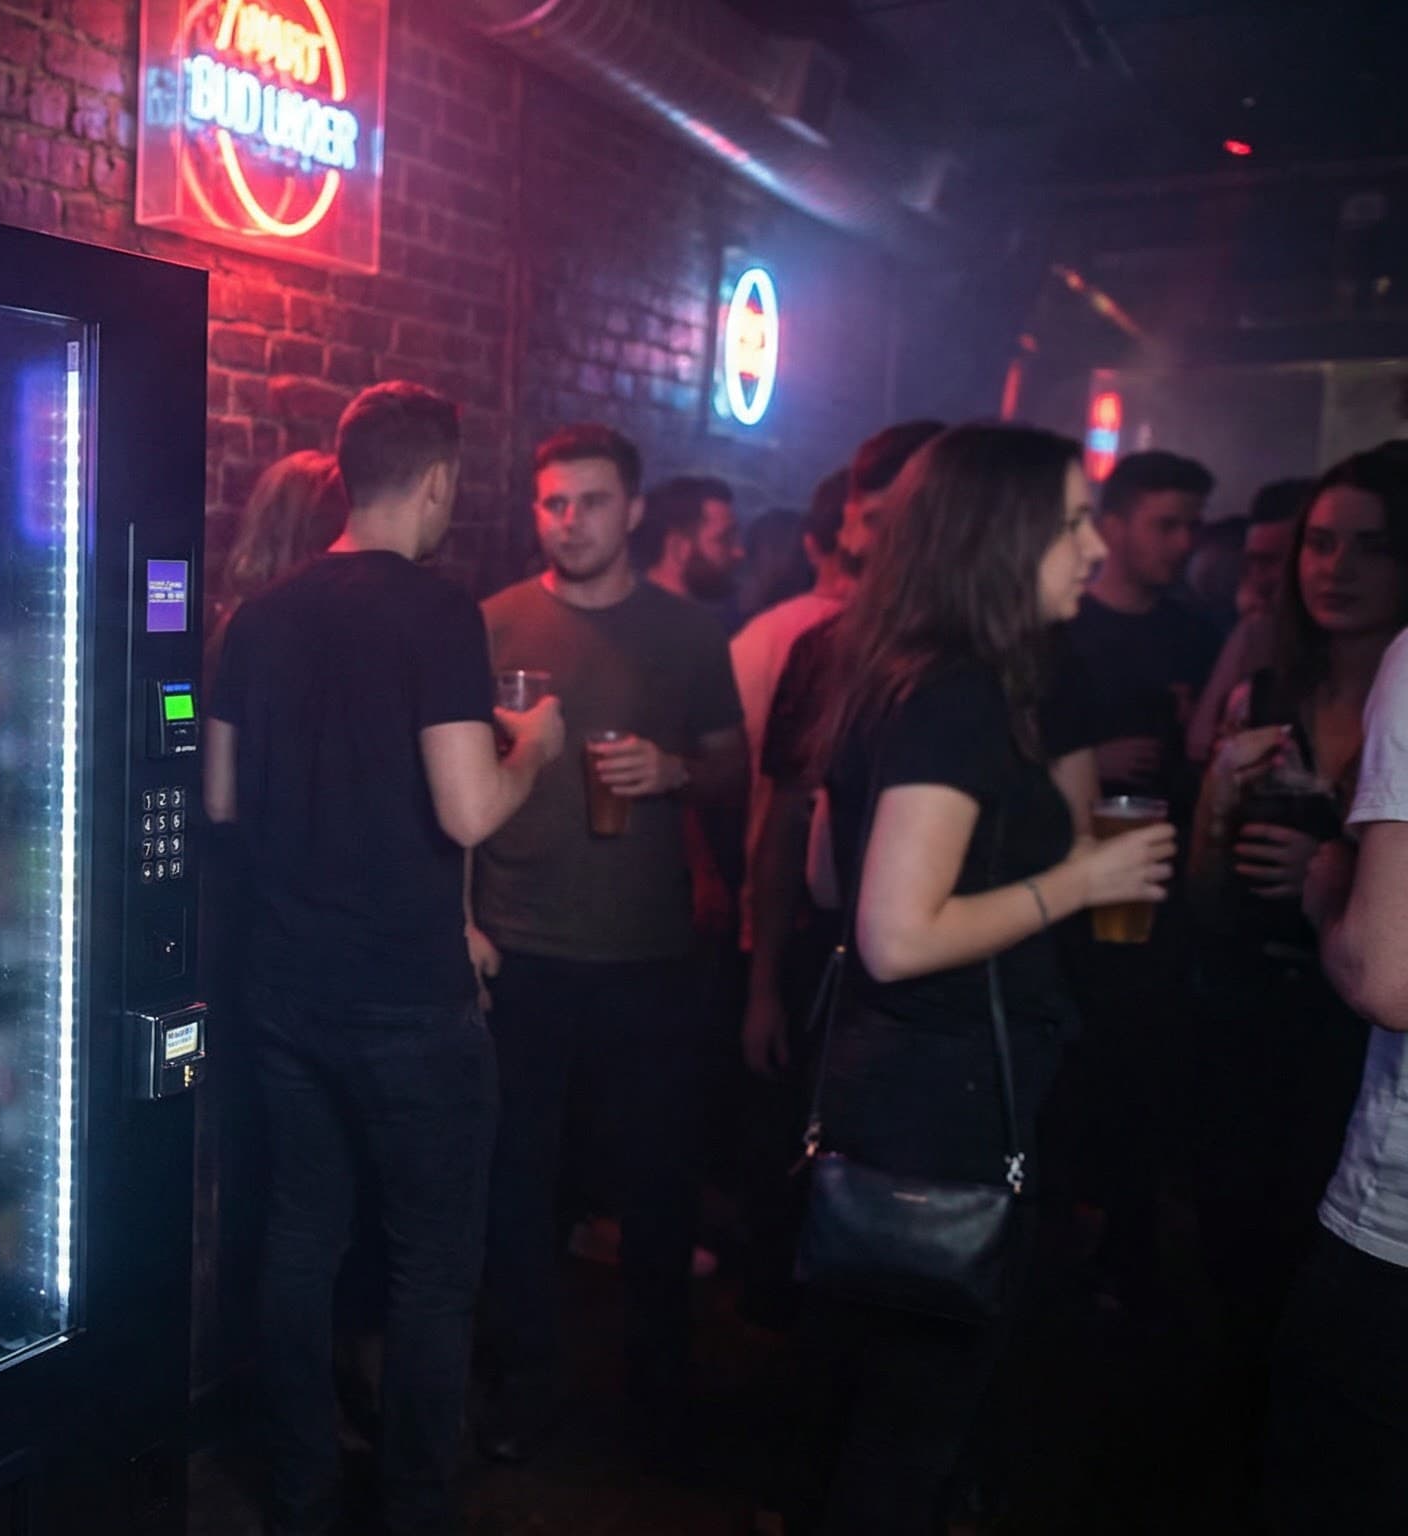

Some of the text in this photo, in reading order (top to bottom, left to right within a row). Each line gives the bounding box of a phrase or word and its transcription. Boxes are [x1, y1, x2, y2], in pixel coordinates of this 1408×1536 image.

[159, 793, 167, 806] 2
[159, 815, 166, 830] 5
[144, 842, 152, 857] 7
